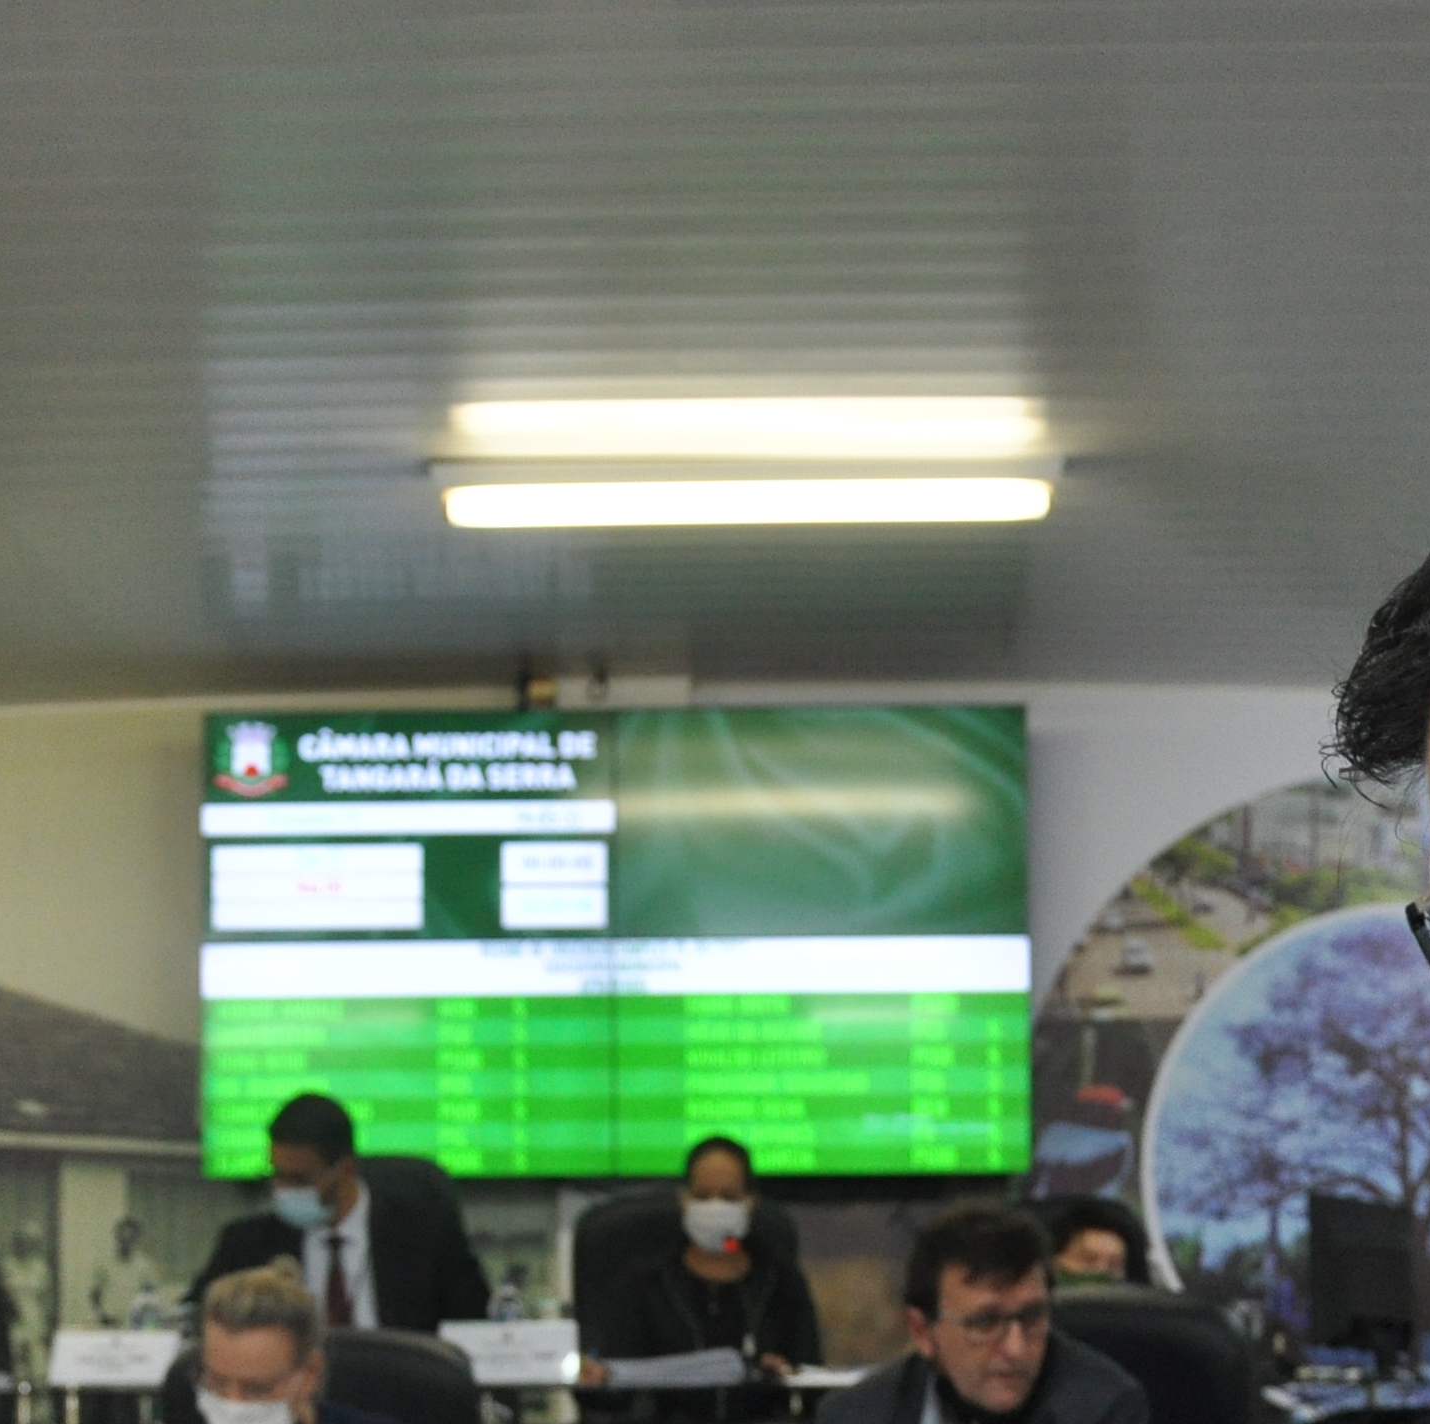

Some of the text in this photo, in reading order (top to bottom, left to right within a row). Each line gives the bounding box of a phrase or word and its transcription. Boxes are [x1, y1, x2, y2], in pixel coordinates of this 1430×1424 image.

[297, 726, 598, 762] CÂMARA MUNICIPAL DE
[318, 757, 577, 793] TANGARÁ DA SERRA
